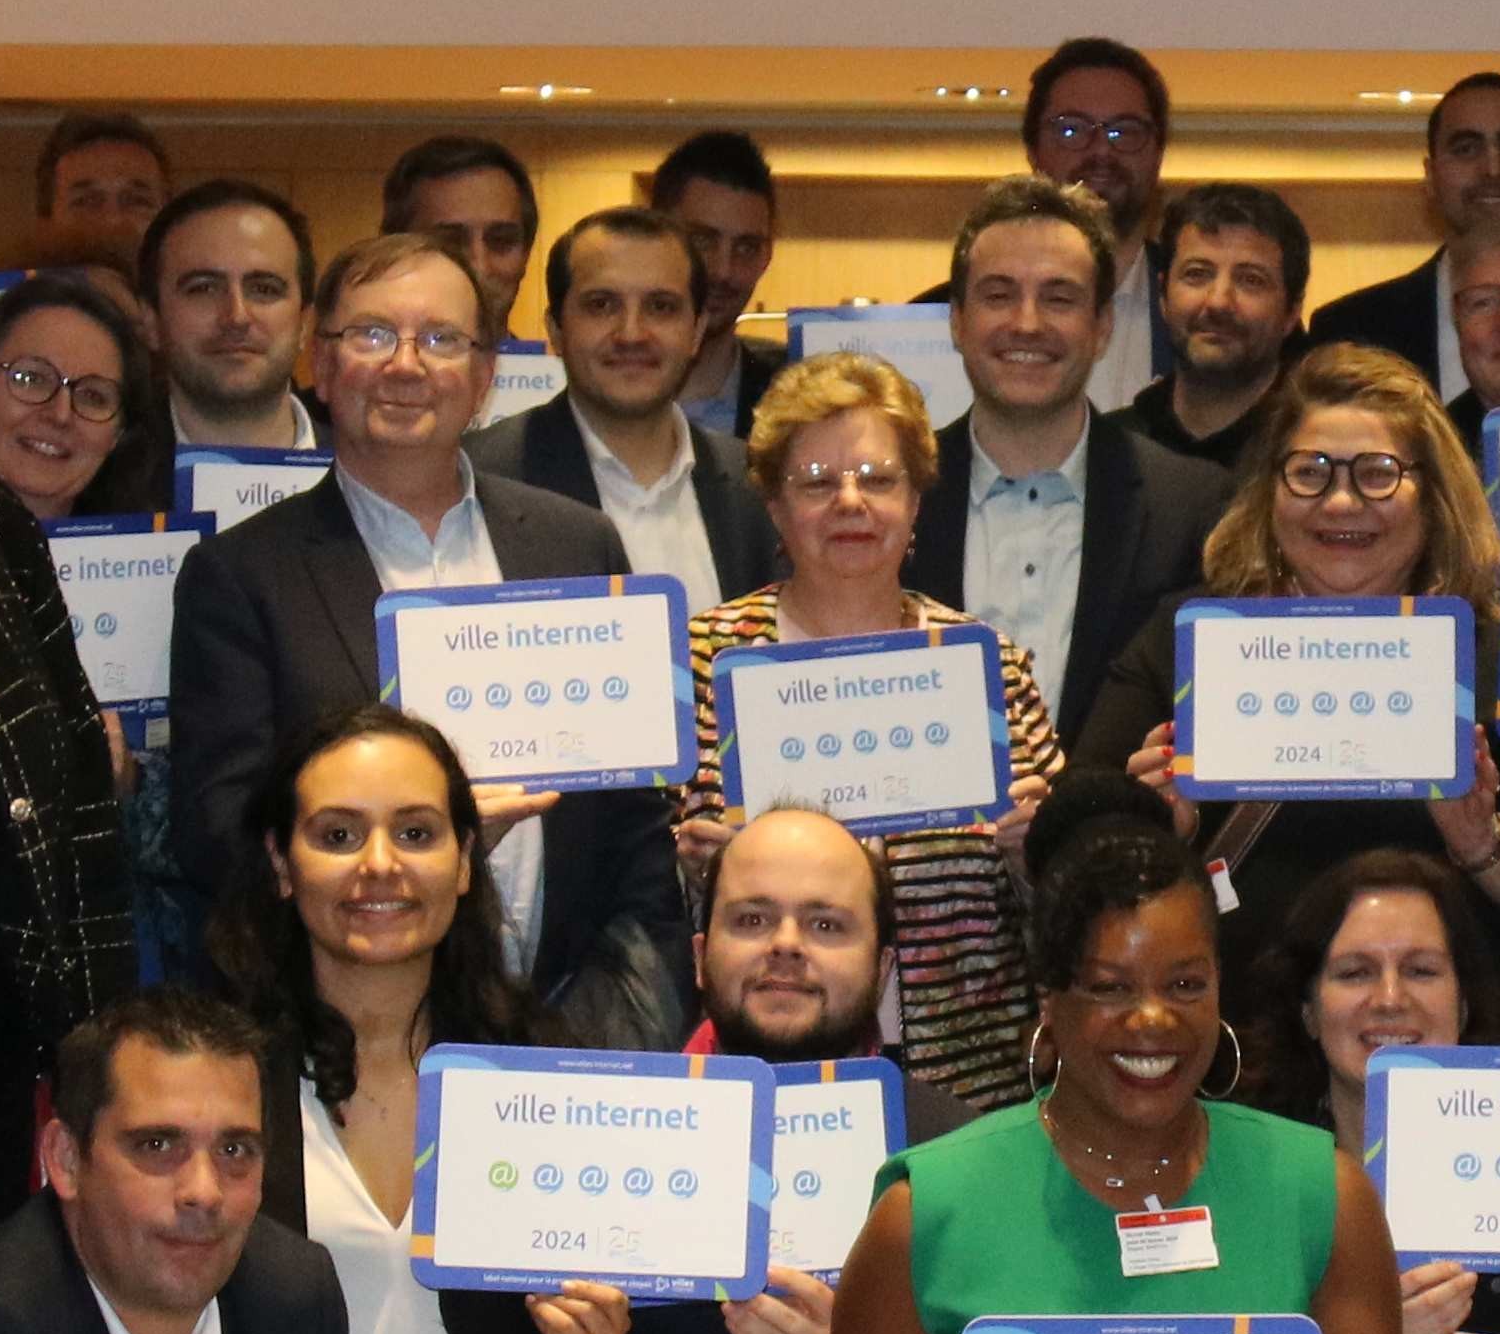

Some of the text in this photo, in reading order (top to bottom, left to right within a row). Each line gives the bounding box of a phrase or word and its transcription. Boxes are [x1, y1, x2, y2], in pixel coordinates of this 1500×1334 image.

[80, 556, 176, 580] internet
[444, 619, 623, 652] ville internet
[1239, 635, 1411, 661] ville internet
[776, 668, 943, 706] ville internet
[489, 739, 538, 759] 2024
[1274, 746, 1321, 763] 2024
[821, 784, 867, 810] 2024
[494, 1093, 699, 1131] ville internet
[1436, 1089, 1494, 1118] ville
[775, 1104, 853, 1135] ernet
[531, 1229, 586, 1251] 2024
